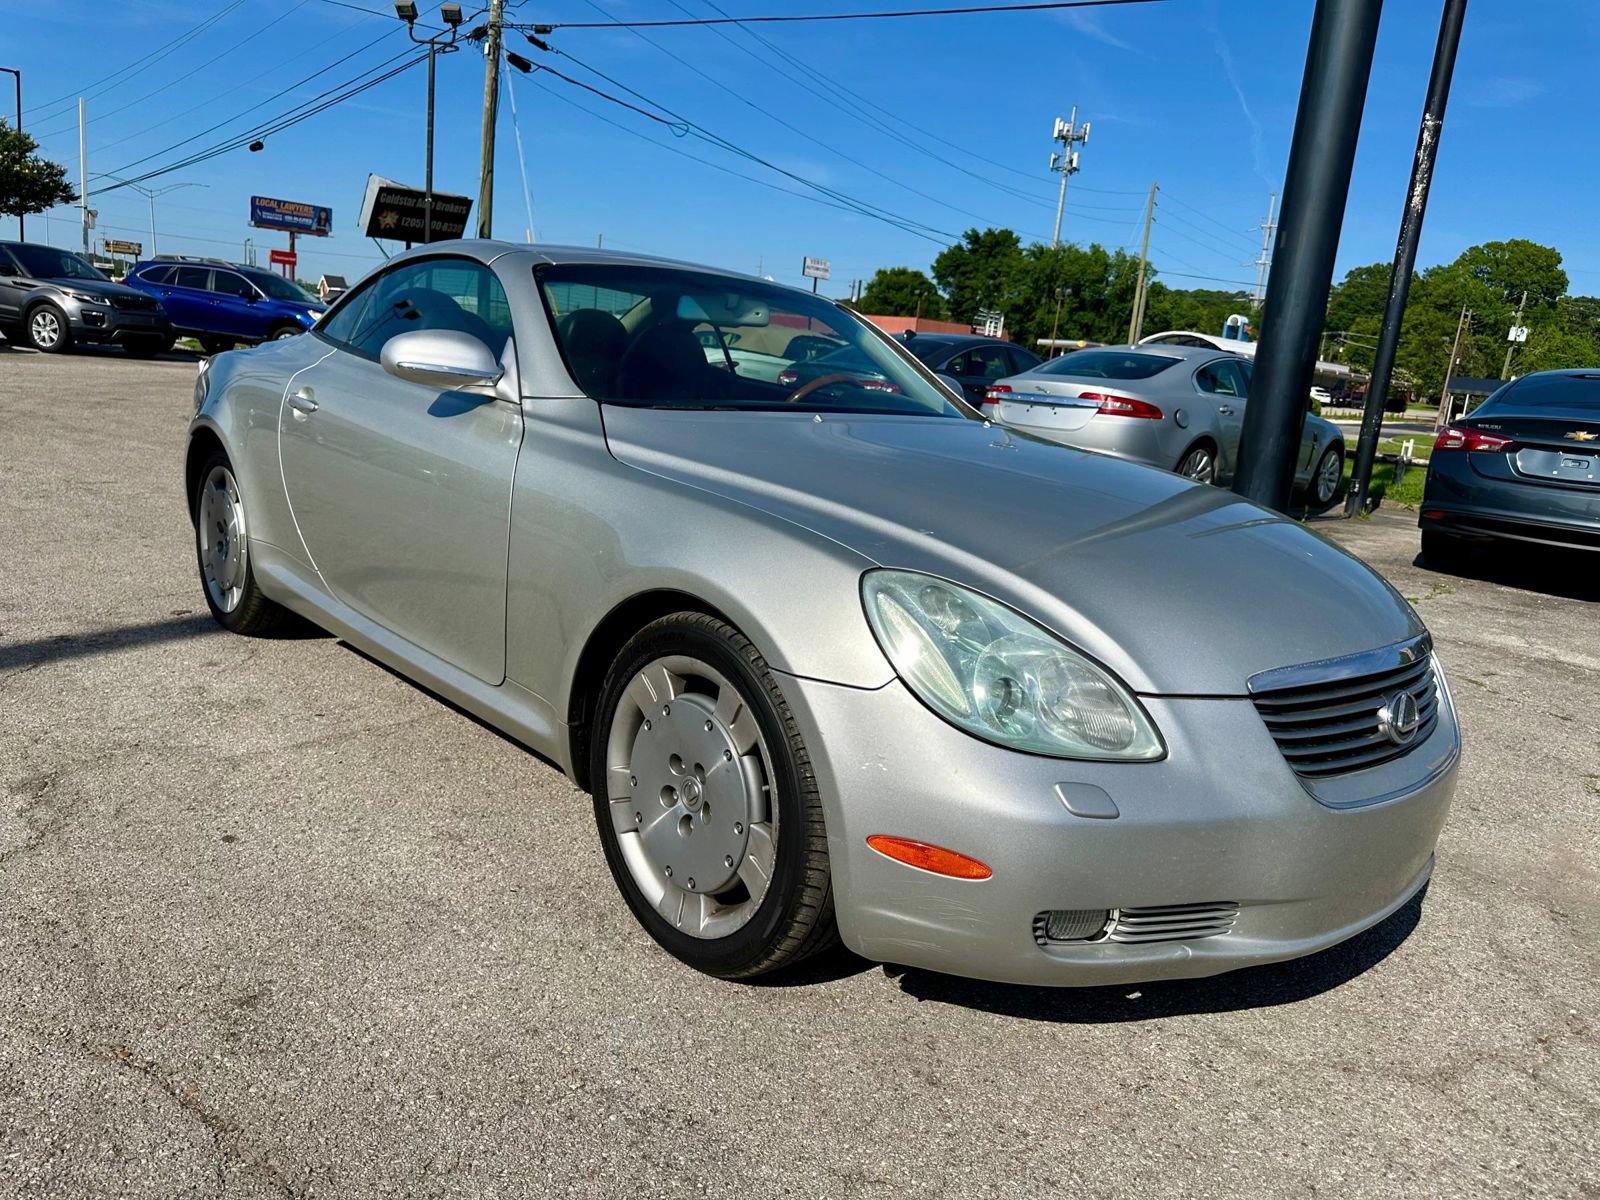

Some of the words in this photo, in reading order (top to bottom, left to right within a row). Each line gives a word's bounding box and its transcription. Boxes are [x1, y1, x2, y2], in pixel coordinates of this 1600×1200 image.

[255, 198, 278, 208] LOCAL
[380, 193, 416, 207] Goldstar
[416, 198, 435, 209] Auo
[436, 201, 468, 214] Brokers
